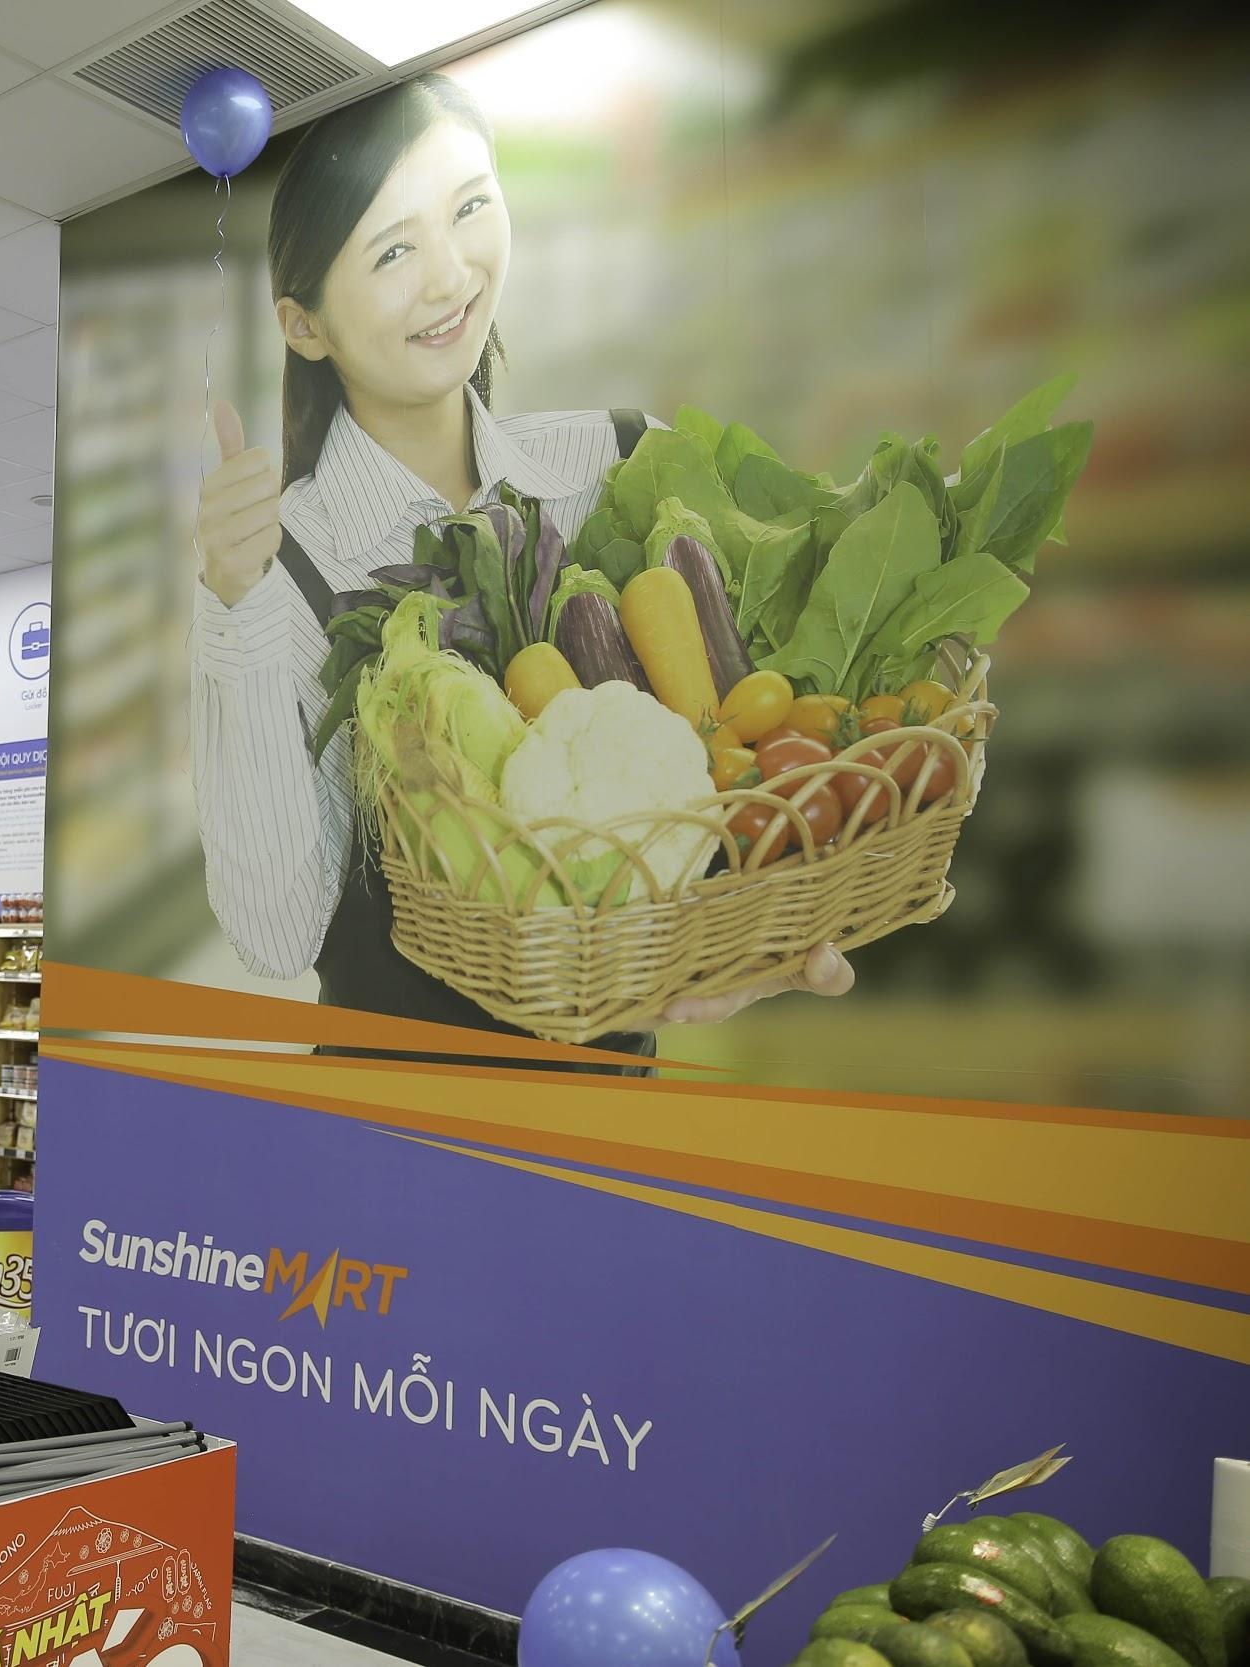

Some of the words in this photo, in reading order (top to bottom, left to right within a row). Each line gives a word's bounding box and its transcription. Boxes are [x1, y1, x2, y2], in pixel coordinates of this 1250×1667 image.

[12, 751, 31, 765] QUY
[79, 1218, 408, 1331] SunshineMART
[78, 1304, 176, 1368] TƯƠI
[195, 1328, 332, 1404] NGON
[354, 1351, 454, 1431] MỖI
[479, 1387, 654, 1472] NGÀY
[47, 1582, 76, 1603] FUJI
[125, 1567, 158, 1597] YOTO
